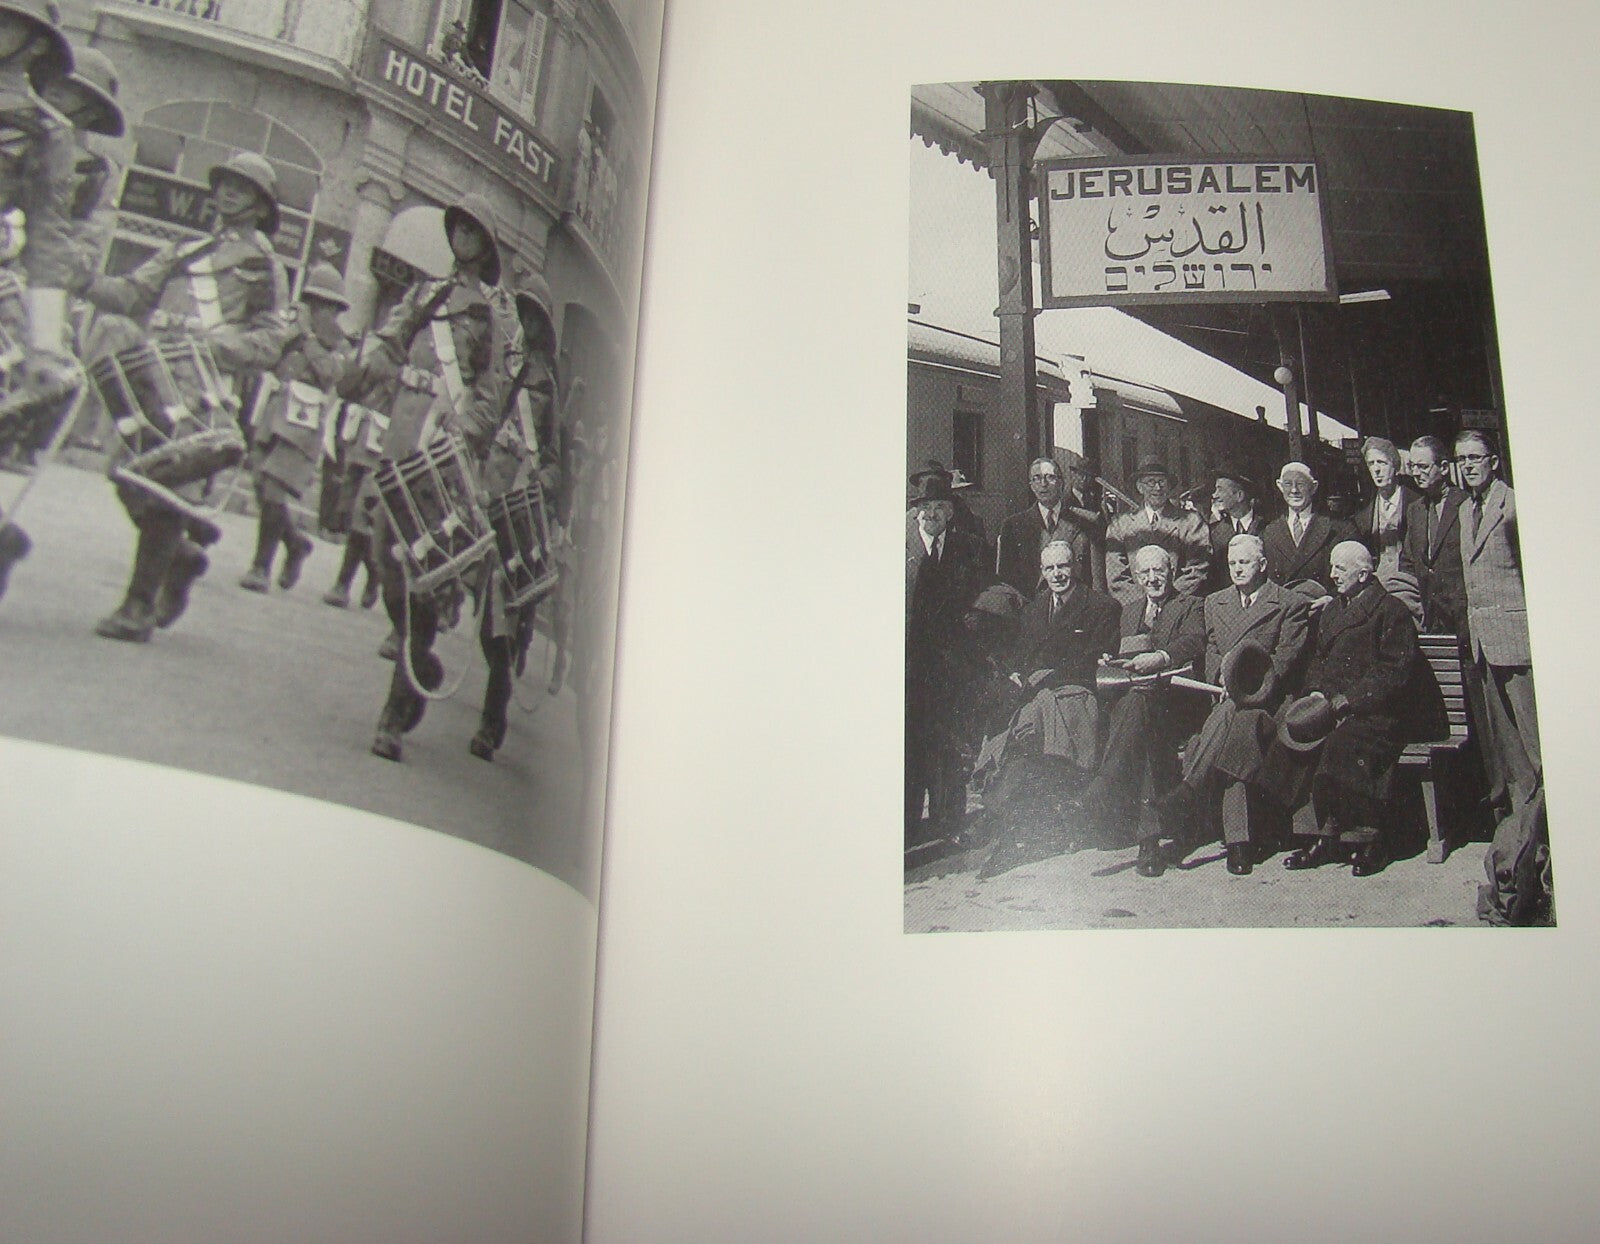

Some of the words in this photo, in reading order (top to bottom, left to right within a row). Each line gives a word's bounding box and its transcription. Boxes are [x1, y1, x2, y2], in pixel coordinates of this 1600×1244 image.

[384, 49, 479, 132] HOTEL
[493, 116, 555, 183] FAST
[1050, 165, 1316, 201] JERUSALEM
[1104, 200, 1266, 261] القدس
[1104, 262, 1272, 292] ירושלים
